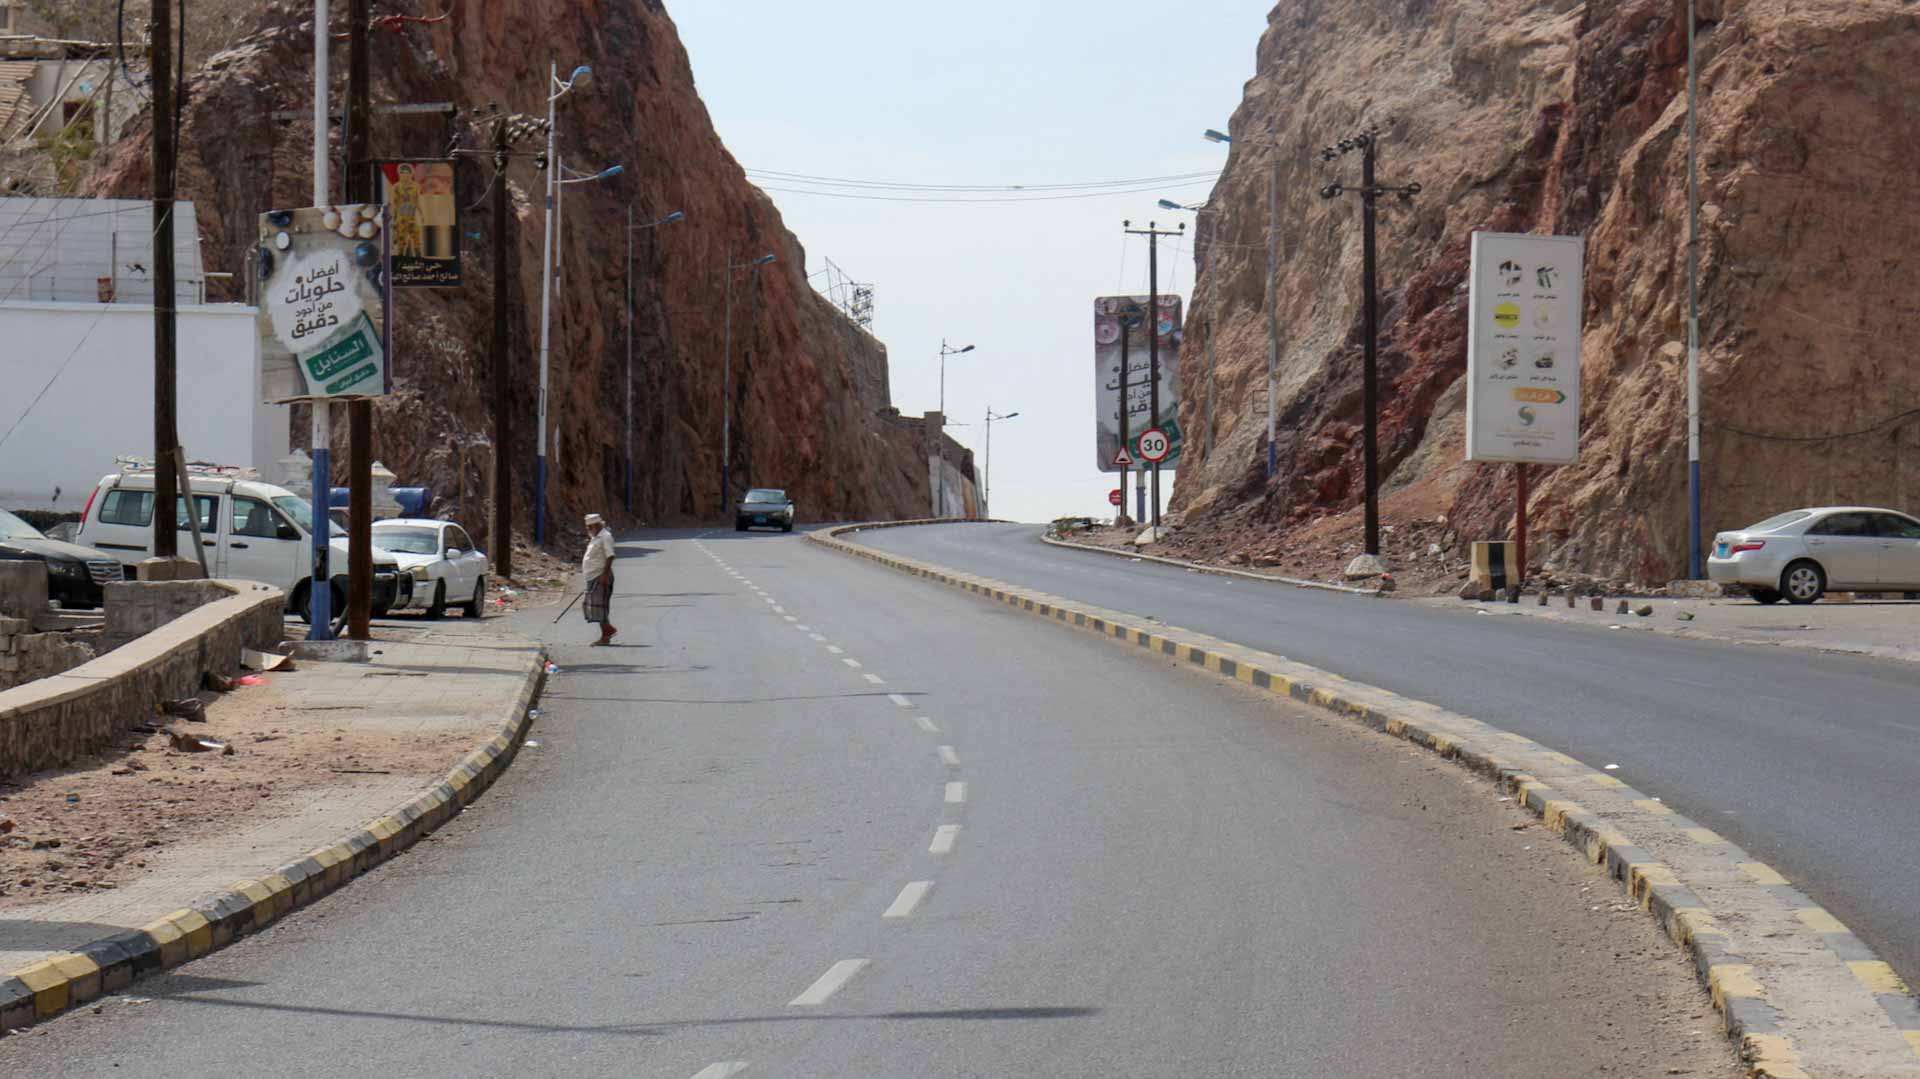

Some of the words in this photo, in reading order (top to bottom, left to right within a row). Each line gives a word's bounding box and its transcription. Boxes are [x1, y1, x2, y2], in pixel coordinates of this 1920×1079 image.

[285, 277, 345, 304] حلويات
[318, 302, 333, 312] من
[291, 313, 338, 339] دقيق
[1143, 439, 1165, 452] 30
